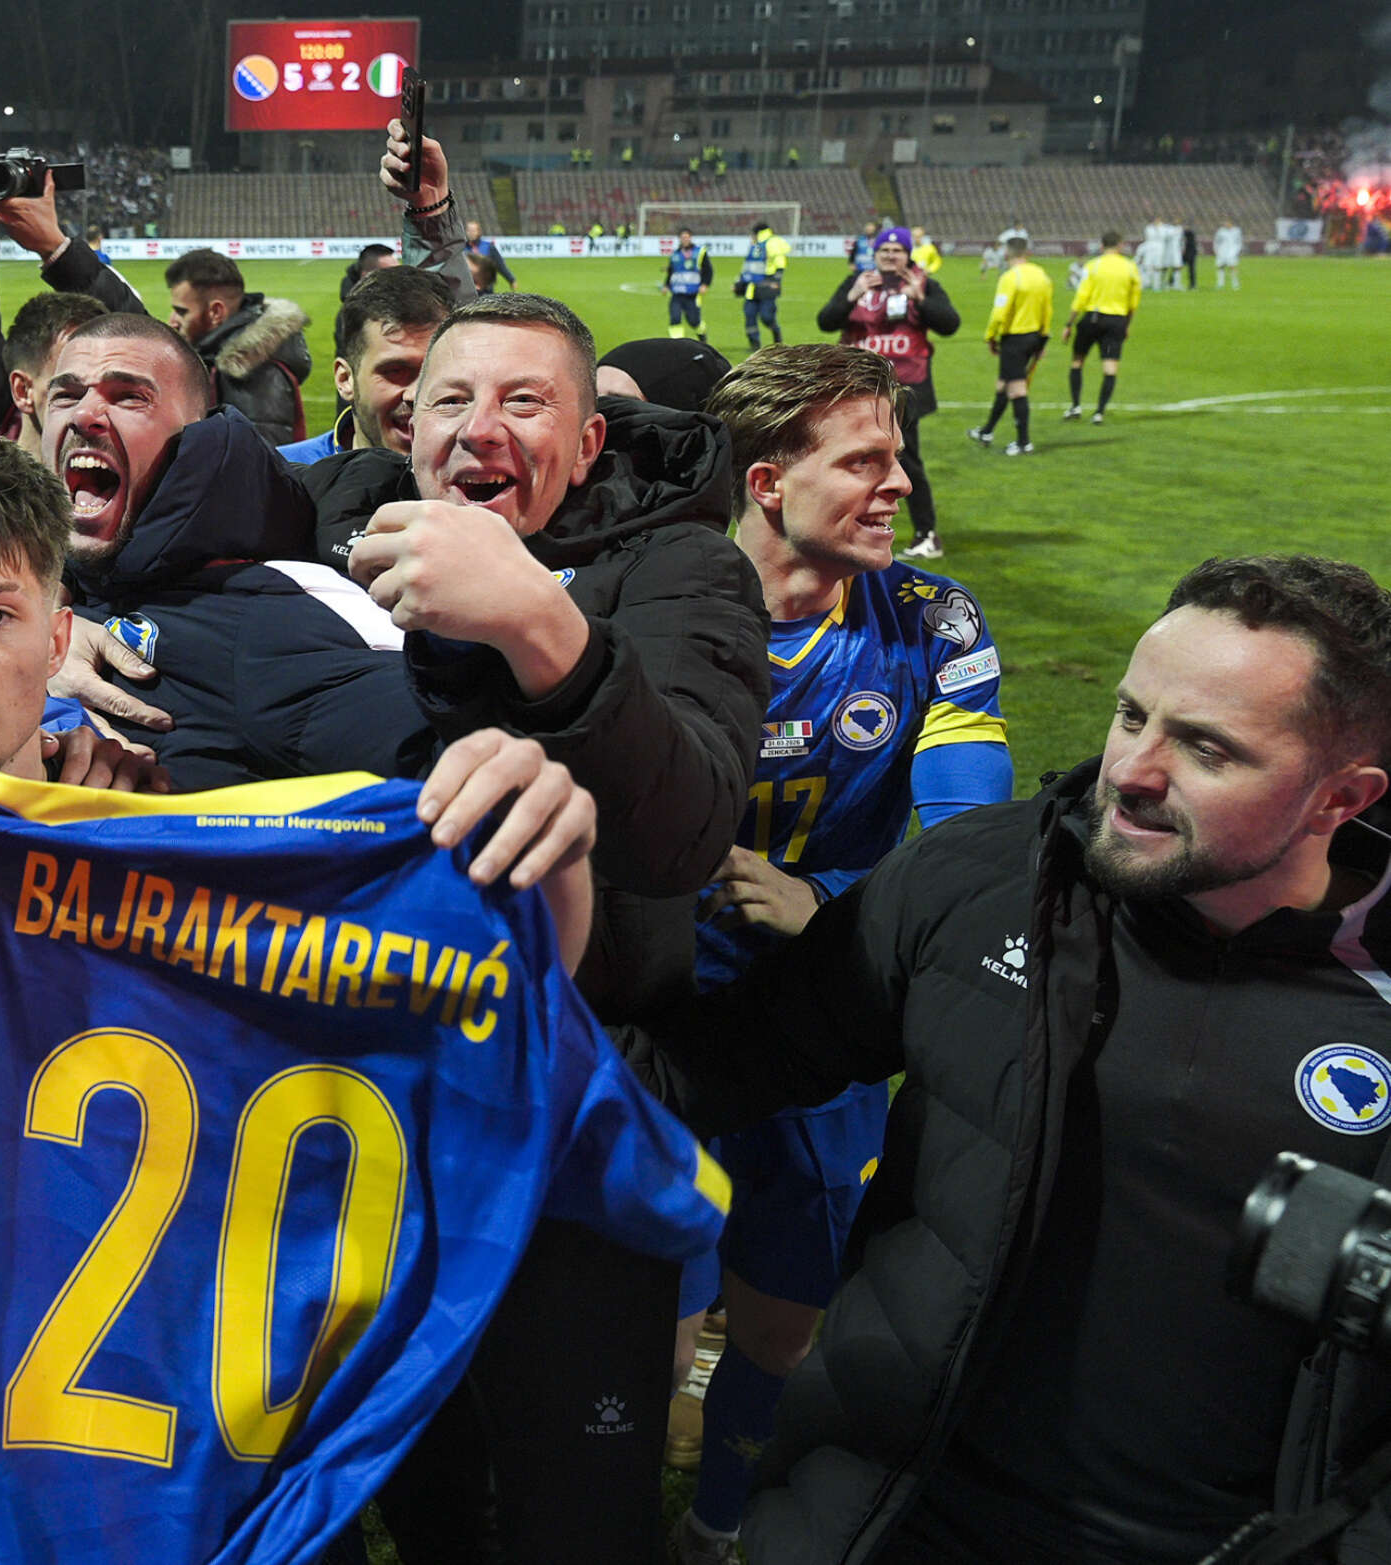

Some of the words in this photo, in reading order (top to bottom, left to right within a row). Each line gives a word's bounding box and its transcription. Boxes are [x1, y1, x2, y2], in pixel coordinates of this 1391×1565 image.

[283, 62, 303, 92] 5
[341, 62, 361, 91] 2
[850, 334, 911, 355] OTO
[331, 544, 350, 557] KEL
[196, 815, 250, 828] Bosnia
[255, 815, 285, 828] and
[288, 815, 386, 835] Herzegovina
[747, 776, 827, 863] 17
[14, 850, 509, 1043] BAJRAKTAREVIĆ
[3, 1026, 407, 1469] 20
[585, 1422, 635, 1435] KELME
